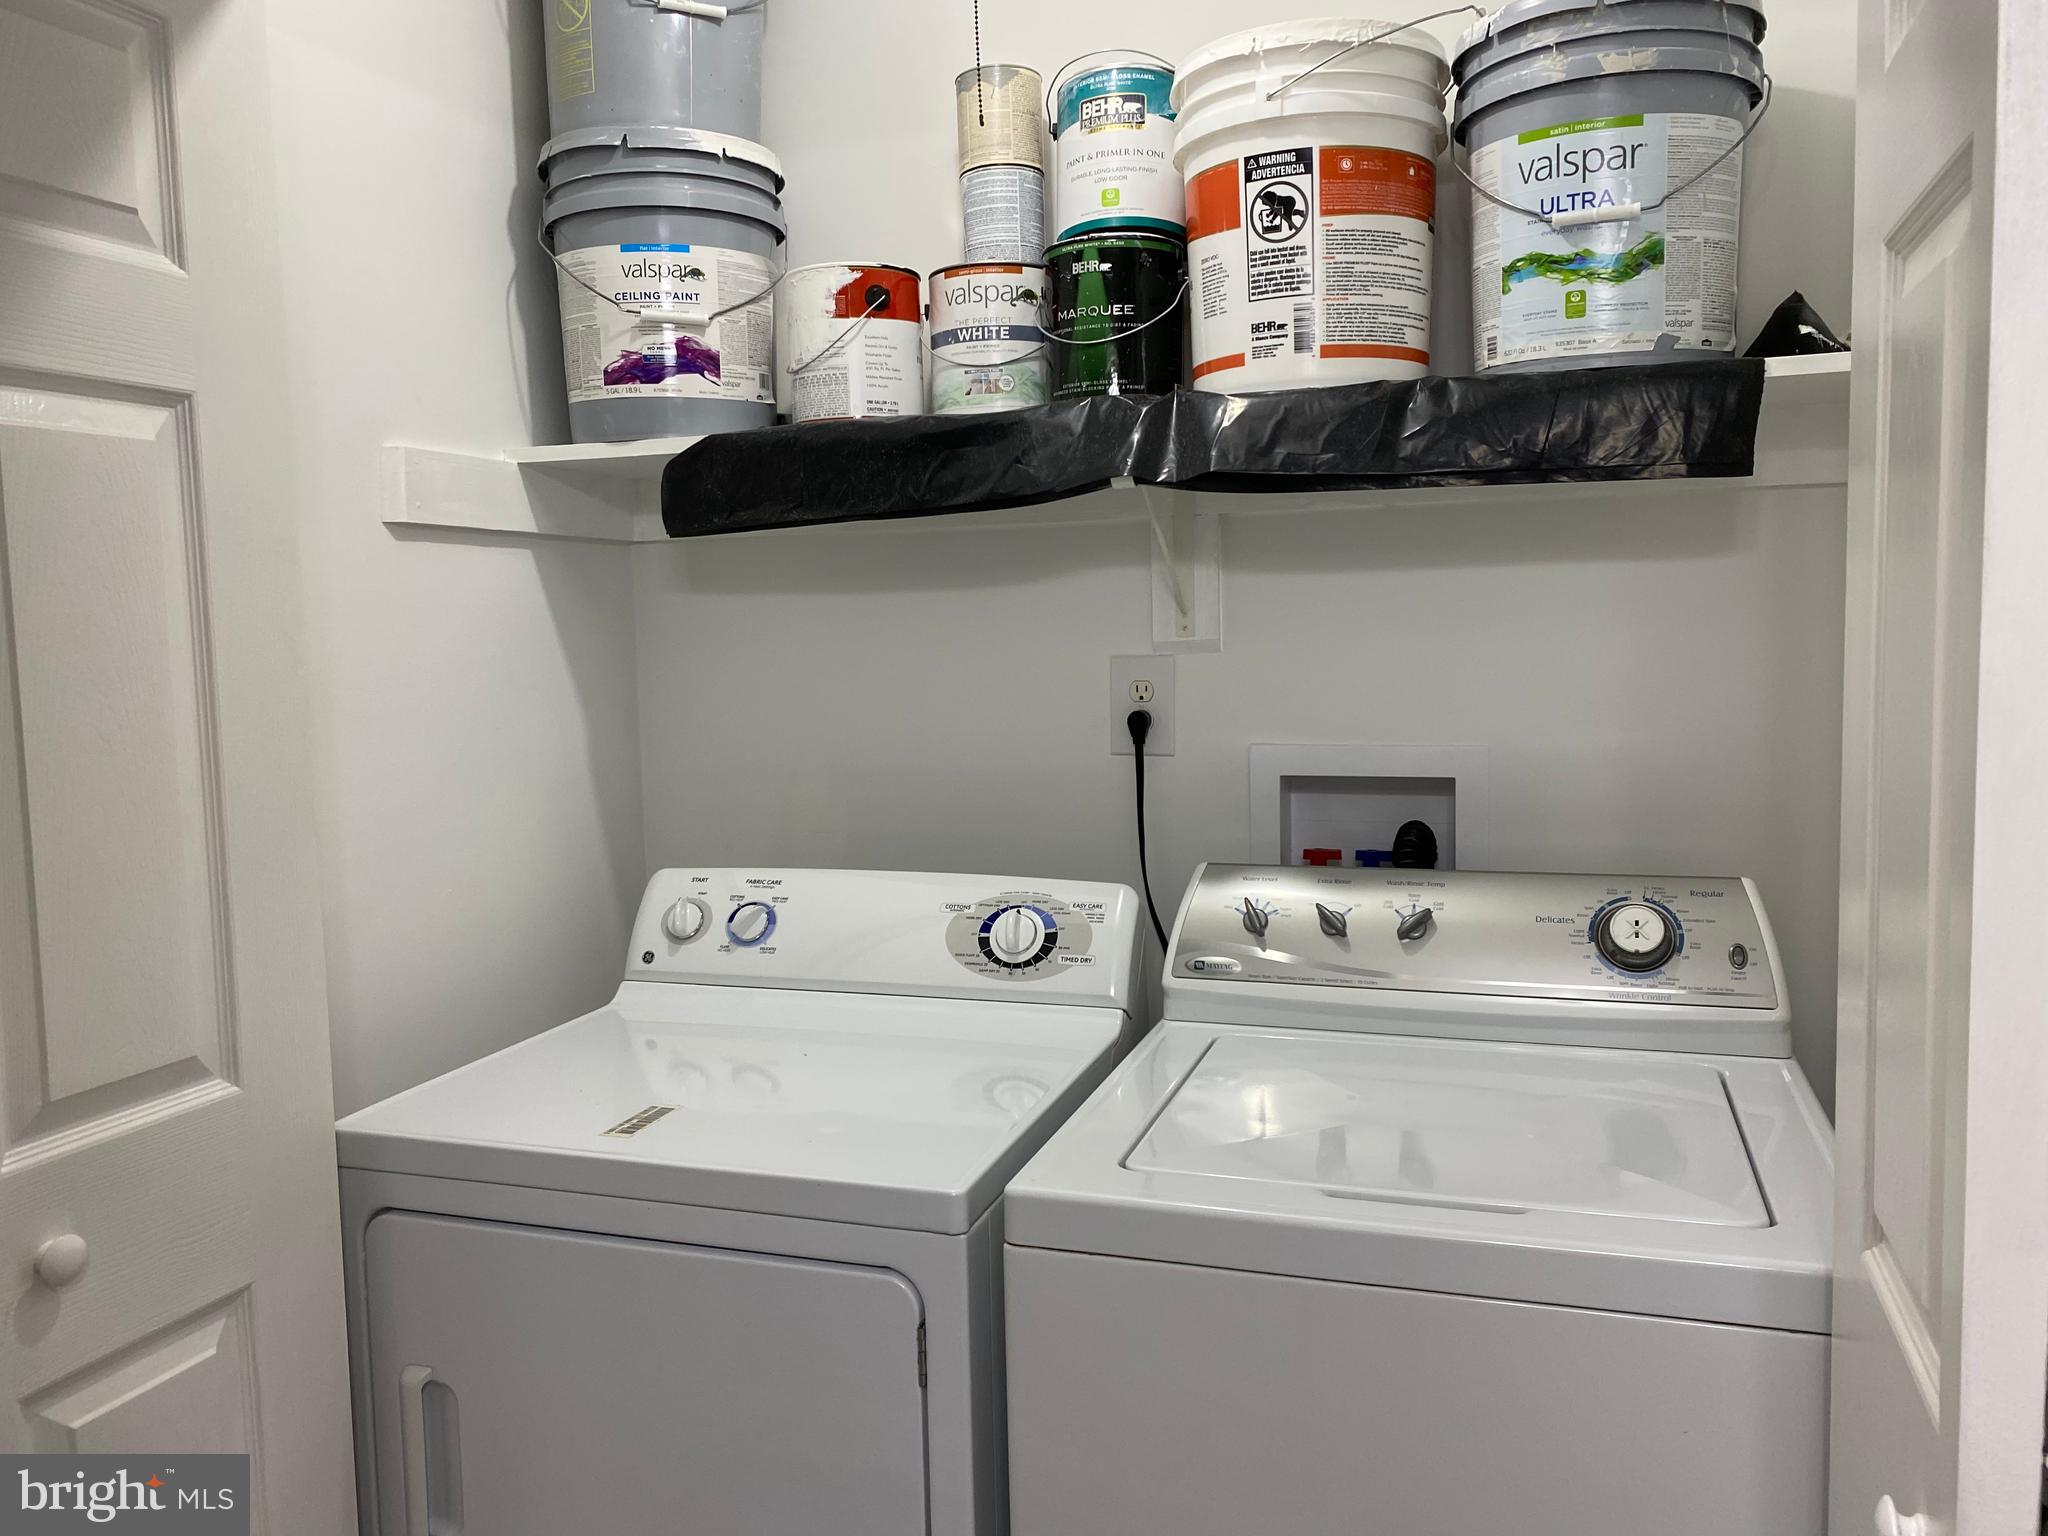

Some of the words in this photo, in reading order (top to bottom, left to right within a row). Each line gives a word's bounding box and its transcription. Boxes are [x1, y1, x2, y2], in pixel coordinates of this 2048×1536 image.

[1133, 73, 1155, 81] ENAMEL
[1082, 96, 1124, 120] BEHR
[1082, 114, 1119, 129] PREMIUM
[1122, 113, 1144, 125] PLUS
[1550, 125, 1570, 136] satin
[1574, 120, 1606, 132] interior
[1066, 155, 1085, 169] PAINT
[1087, 153, 1094, 161] &
[1096, 148, 1130, 159] PRIMER
[1133, 148, 1144, 156] IN
[1146, 149, 1166, 160] ONE
[1258, 151, 1297, 167] WARNING
[1518, 142, 1645, 185] valspar
[1138, 166, 1158, 174] FINISH
[1251, 163, 1305, 181] ADVERTENCIA
[1094, 176, 1108, 184] LOW
[1108, 174, 1128, 182] ODOR
[1540, 189, 1615, 215] ULTRA
[621, 258, 691, 283] valspar
[1072, 260, 1100, 275] BEHR
[614, 291, 661, 301] CEILING
[665, 292, 700, 302] PAINT
[945, 279, 1024, 308] valspar
[1058, 304, 1135, 322] MARQUEE
[955, 319, 970, 327] THE
[973, 316, 1012, 325] PERFECT
[1074, 323, 1101, 331] RESISTANCE
[1251, 321, 1277, 334] BEHR
[1664, 317, 1694, 329] valspar
[957, 326, 1010, 342] WHITE
[1386, 879, 1425, 887] Wash/Rinse
[1689, 889, 1725, 899] Regular
[1535, 915, 1576, 924] Delicates
[1206, 962, 1233, 971] MAYTAG
[1608, 992, 1639, 1000] Wrinkle
[1641, 992, 1672, 1002] Control
